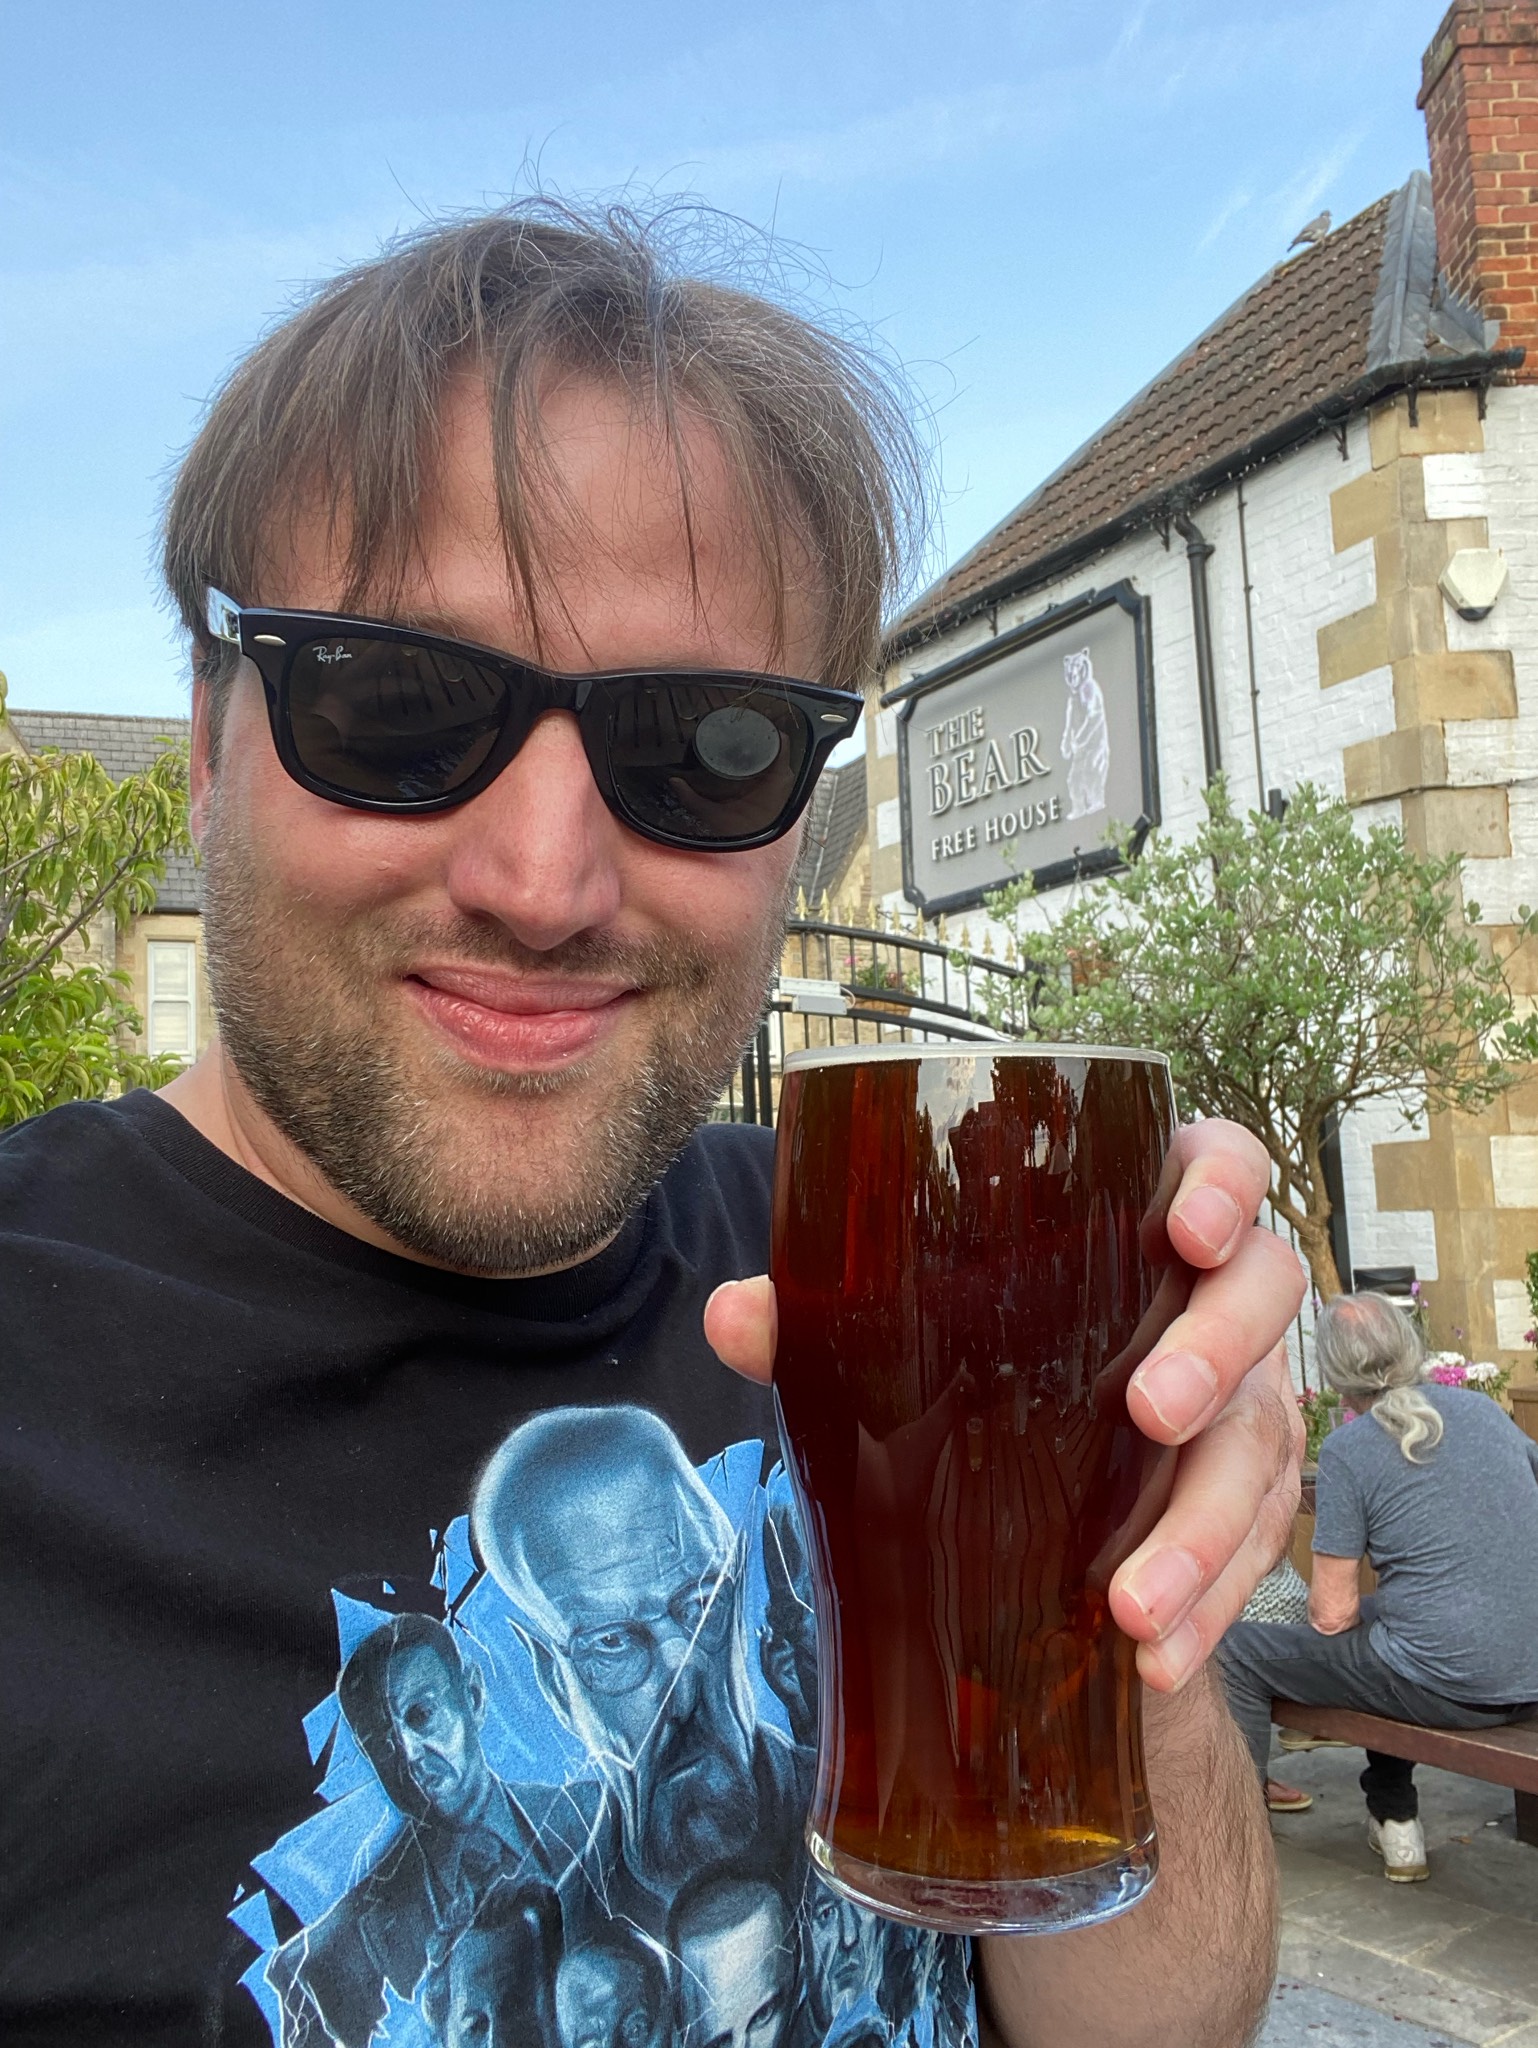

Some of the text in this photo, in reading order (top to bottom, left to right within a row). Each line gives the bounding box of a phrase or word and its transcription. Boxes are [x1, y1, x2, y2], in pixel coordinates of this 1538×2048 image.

[312, 645, 353, 664] Ray-Ban
[925, 706, 984, 758] THE
[927, 726, 1050, 816] BEAR
[931, 796, 1061, 861] FREE HOUSE
